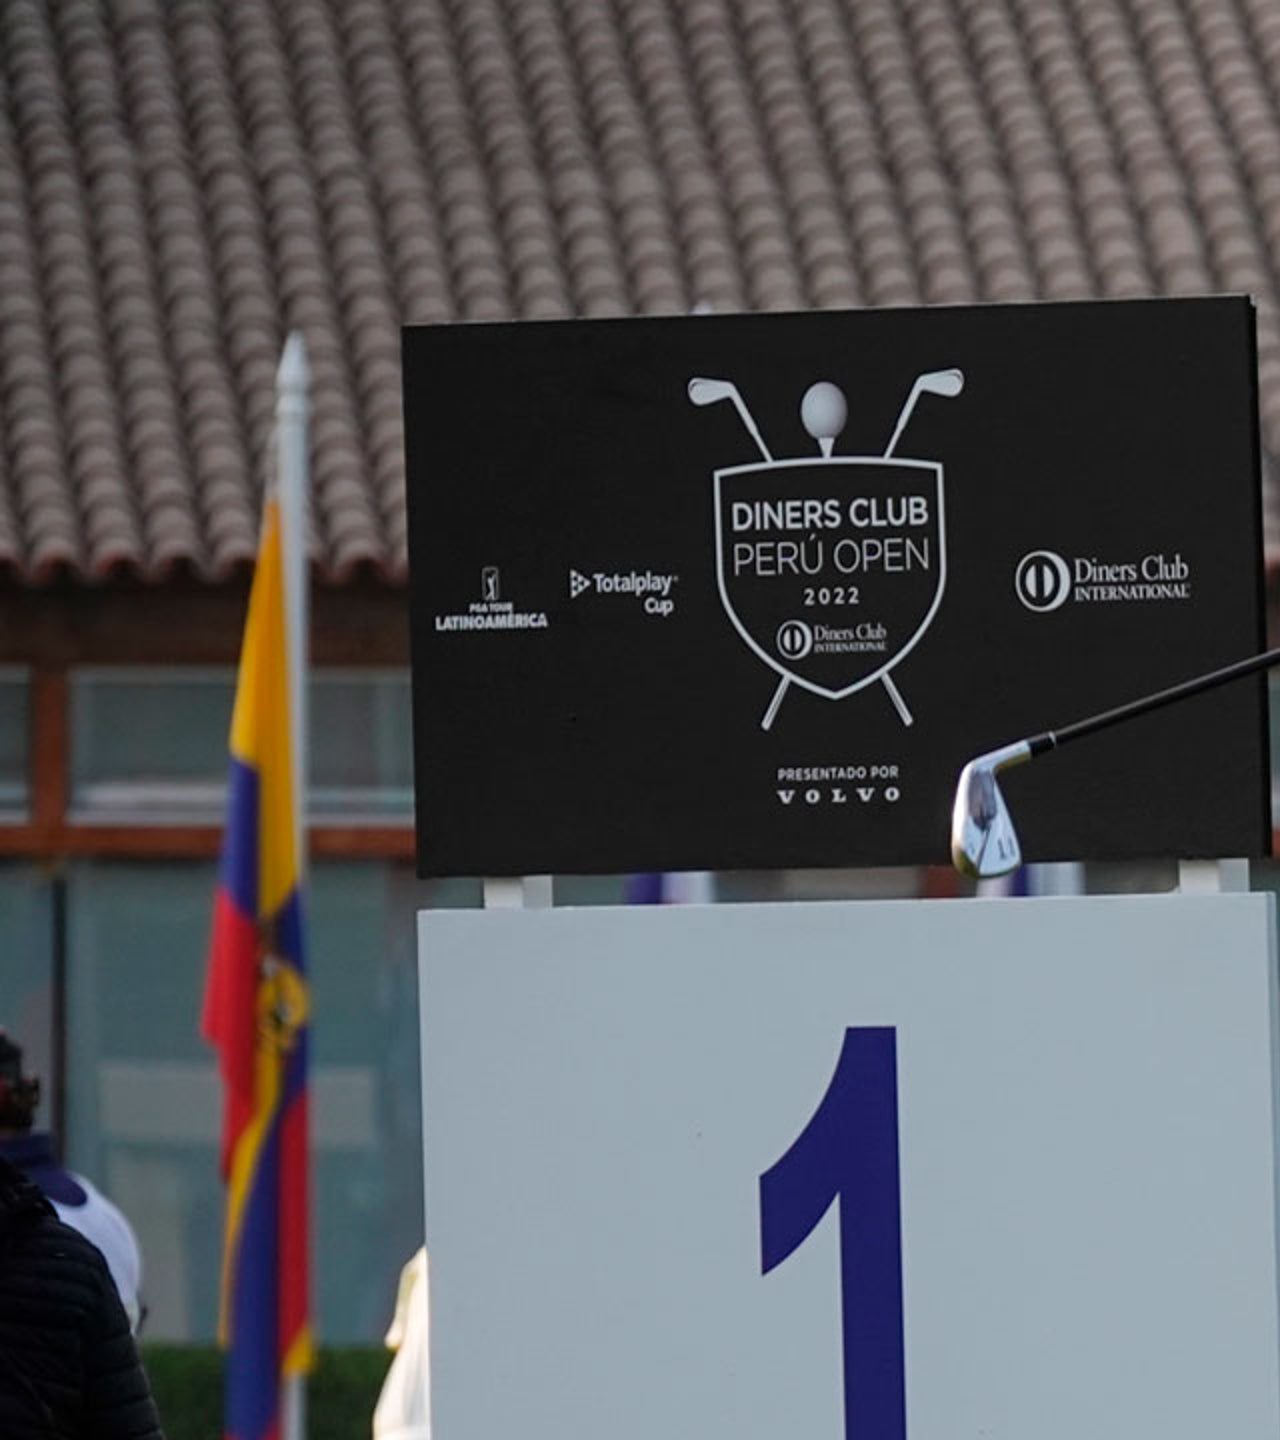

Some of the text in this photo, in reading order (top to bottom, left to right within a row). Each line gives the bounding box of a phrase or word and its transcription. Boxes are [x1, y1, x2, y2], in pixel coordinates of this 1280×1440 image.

[732, 496, 929, 531] DINERS CLUB
[733, 533, 929, 576] PERÚ OPEN
[1074, 553, 1189, 583] Diners Club
[593, 571, 672, 596] Totalplay
[1074, 583, 1190, 601] INTERNATIONAL
[804, 587, 860, 606] 2022
[469, 602, 513, 613] PGA TOUR
[645, 597, 674, 616] Cup
[436, 612, 548, 630] LATINOAMÉRICA
[814, 623, 887, 641] Diners Club
[814, 641, 886, 653] INTERNATIONAL
[777, 765, 899, 781] PRESENTADO POR
[777, 786, 900, 804] VOLVO
